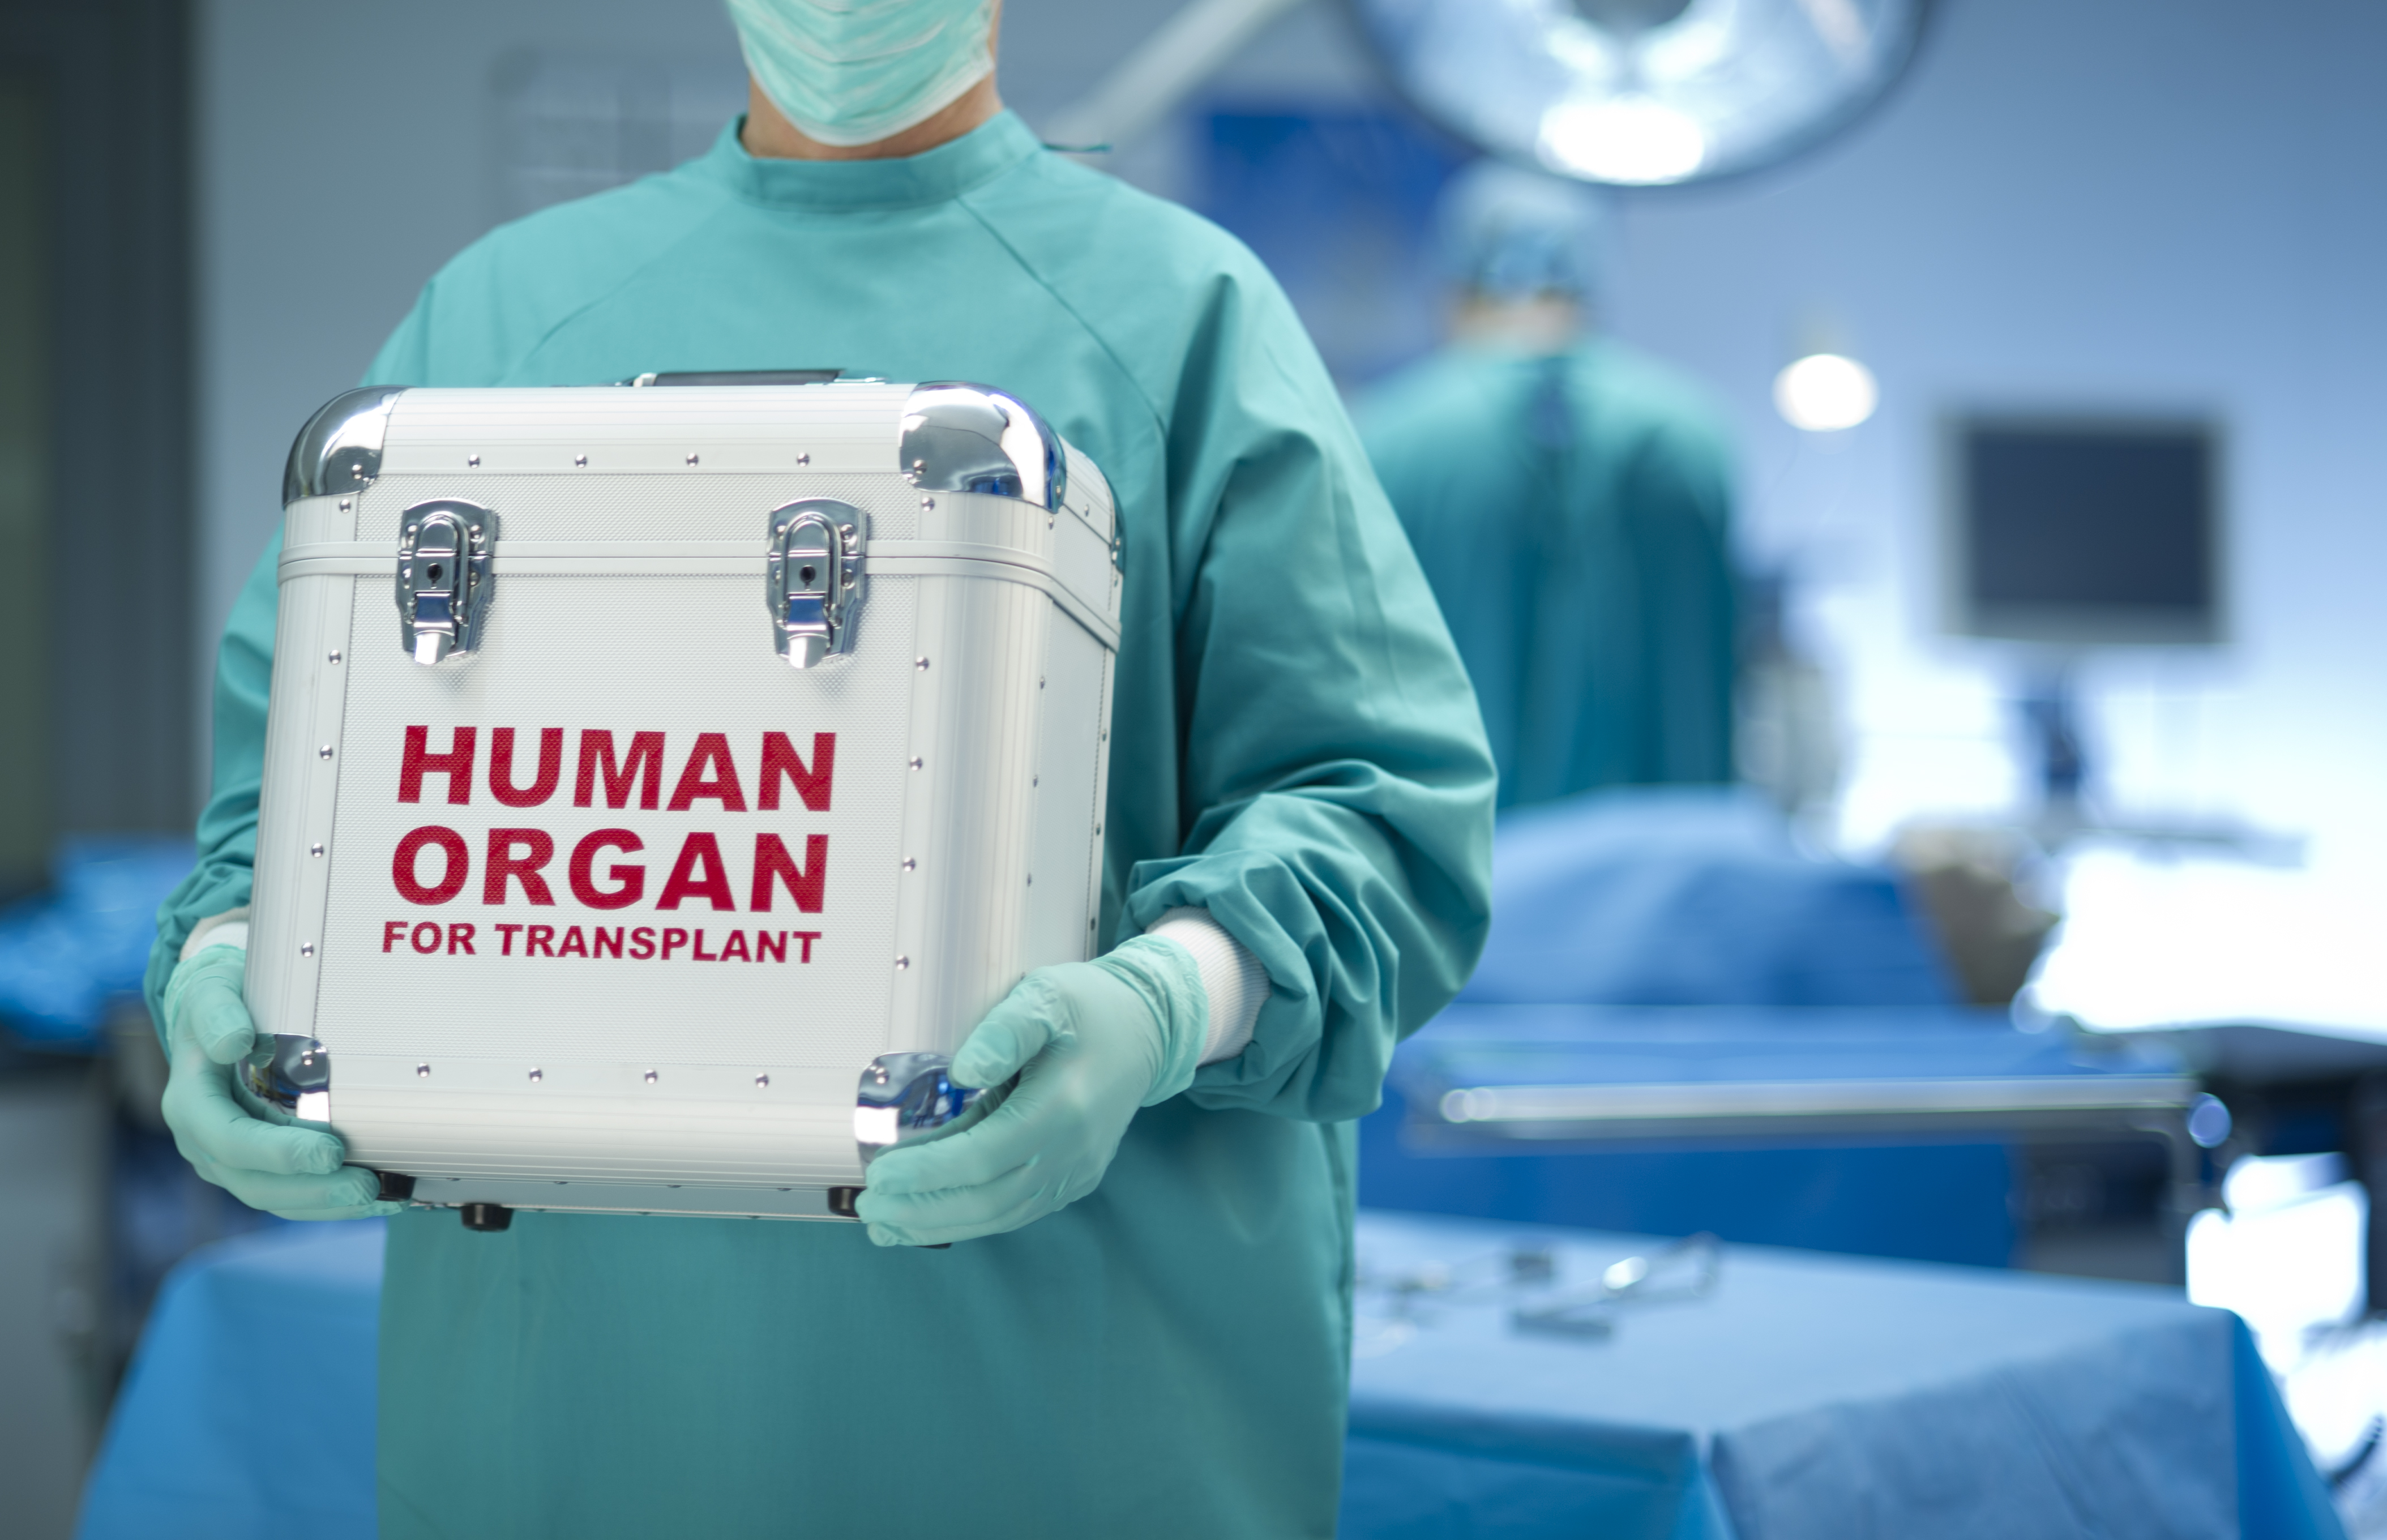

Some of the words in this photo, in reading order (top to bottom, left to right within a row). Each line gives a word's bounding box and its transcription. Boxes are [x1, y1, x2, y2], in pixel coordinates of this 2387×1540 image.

[397, 725, 836, 812] HUMAN
[392, 825, 828, 913] ORGAN
[382, 921, 475, 955] FOR
[495, 923, 822, 963] TRANSPLANT
